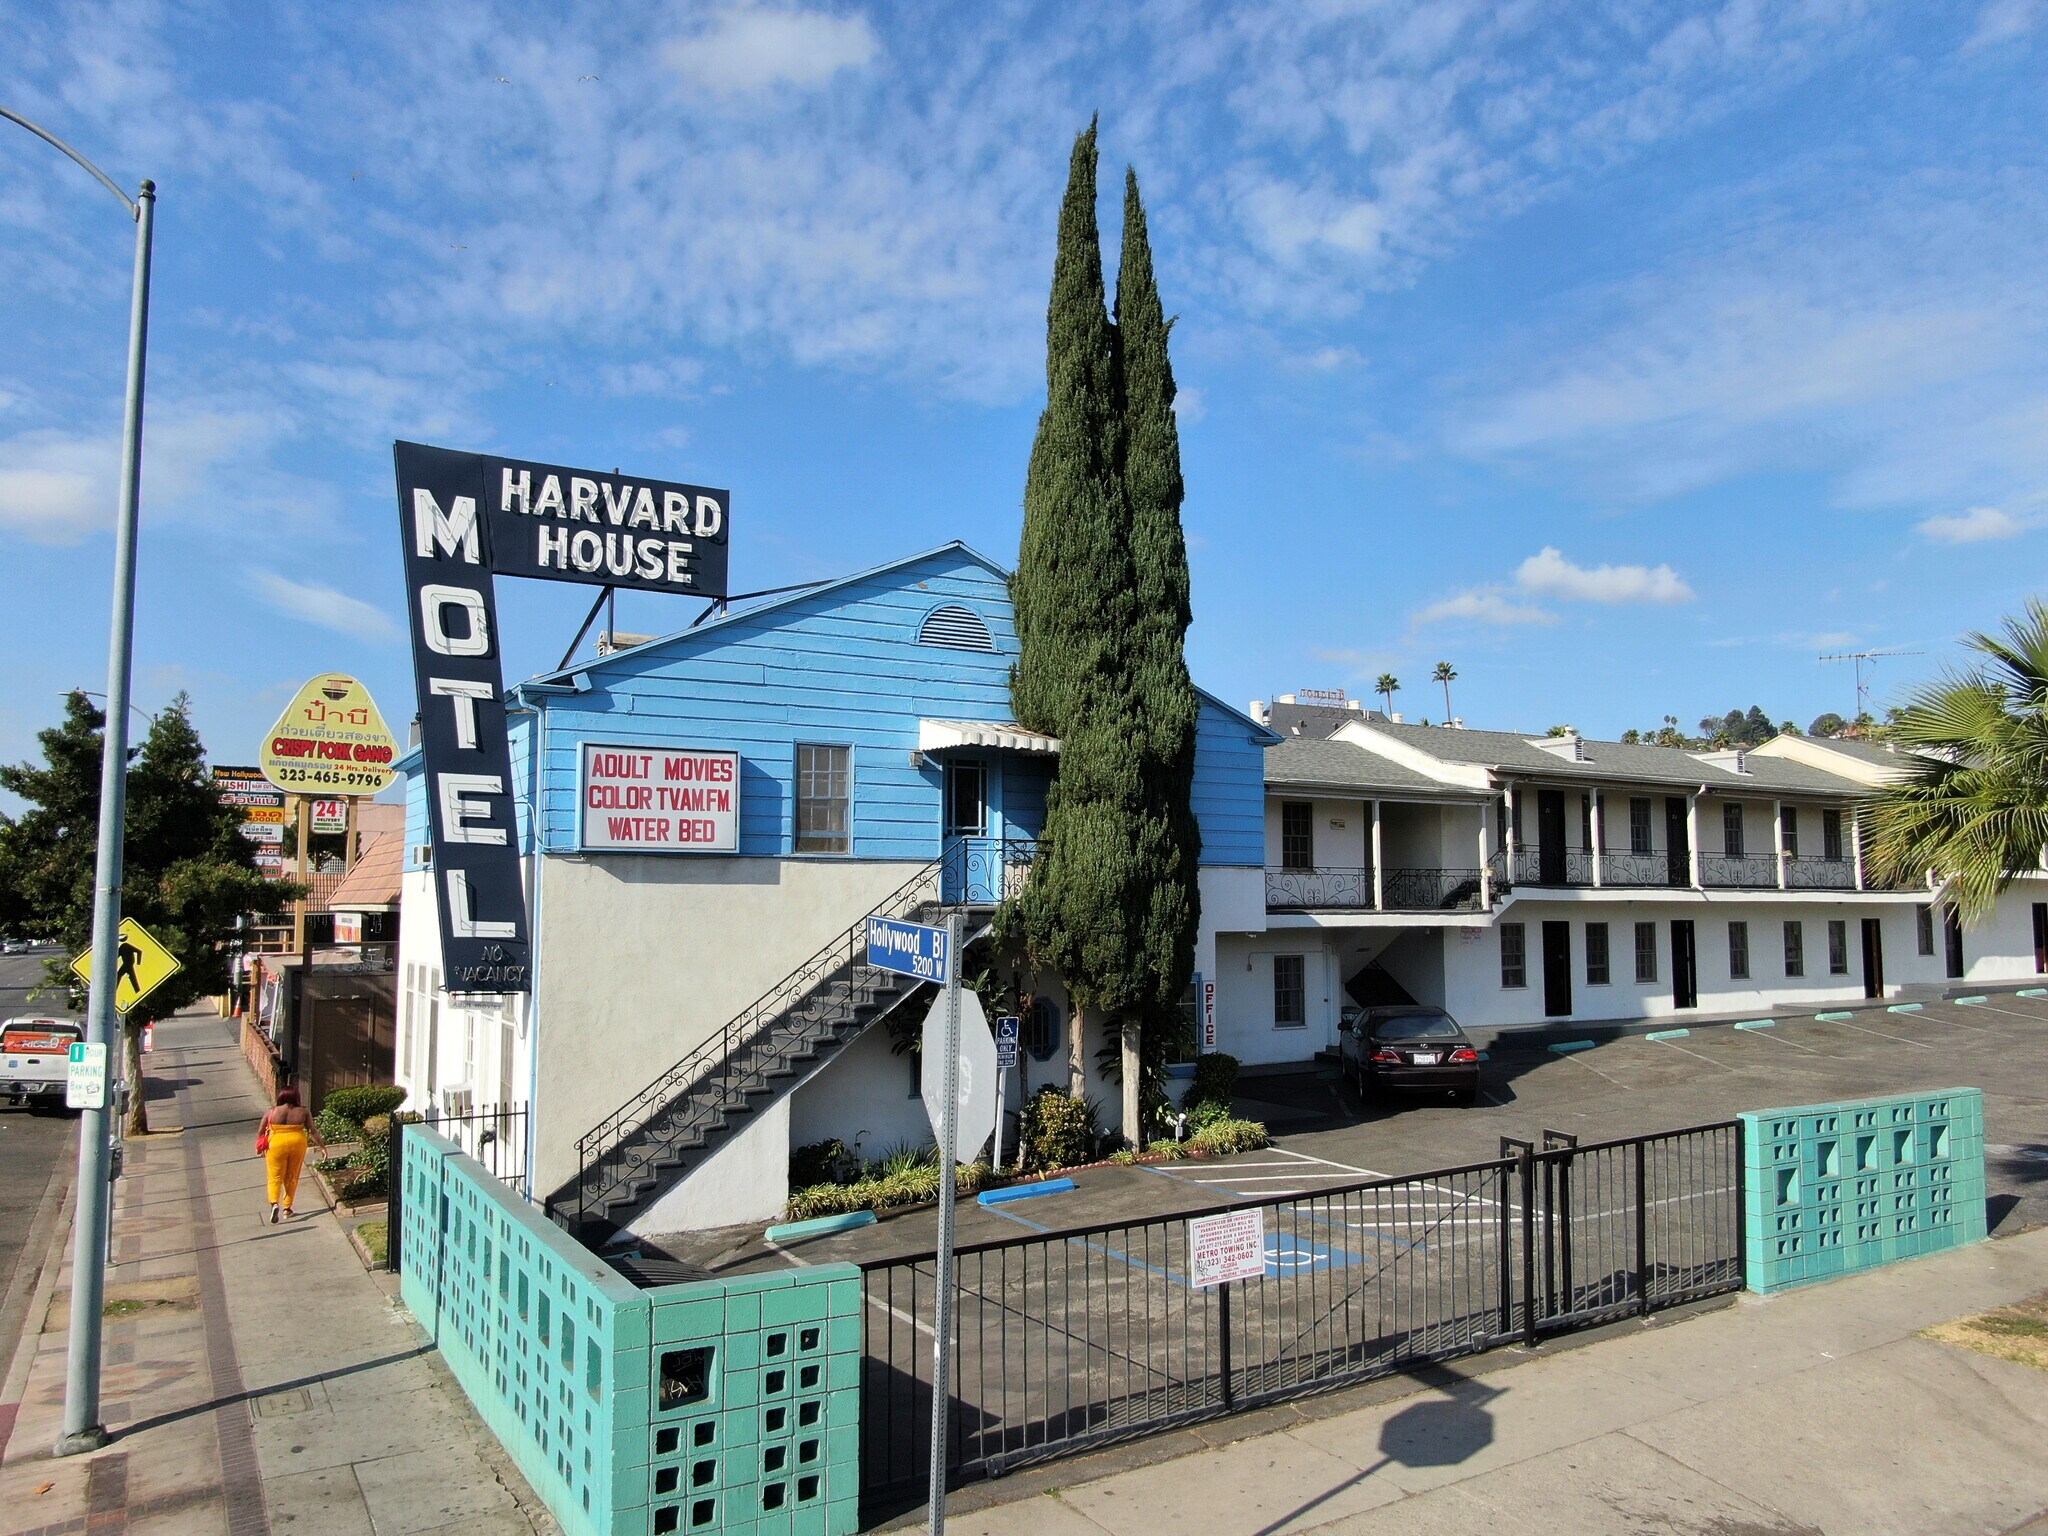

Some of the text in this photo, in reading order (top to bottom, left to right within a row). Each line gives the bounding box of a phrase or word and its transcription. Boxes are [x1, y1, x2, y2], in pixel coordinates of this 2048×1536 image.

[502, 467, 722, 538] HARVARD
[538, 524, 692, 584] HOUSE
[414, 488, 516, 938] MOTEL
[272, 738, 392, 764] CRISPY PORK GANG
[231, 770, 264, 779] Hollywoo
[280, 769, 382, 786] 323-465-9796
[363, 766, 392, 775] Delivery
[592, 754, 733, 782] ADULT MOVIES
[589, 785, 652, 810] COLOR
[316, 801, 336, 817] 24
[608, 817, 715, 843] WATER BED
[870, 920, 943, 959] Hollywood Bl
[481, 945, 503, 961] NO
[456, 966, 524, 982] VACANCY
[913, 955, 943, 978] 5200 W
[1205, 984, 1214, 1044] OFFICE
[75, 1046, 80, 1060] 1
[71, 1066, 103, 1077] PARKING
[1195, 1219, 1226, 1229] UNAUTHORIZED
[1233, 1214, 1258, 1222] IMPROPERLY
[1196, 1241, 1260, 1260] METRO TOWING INC.
[1224, 1251, 1254, 1263] 342-0602
